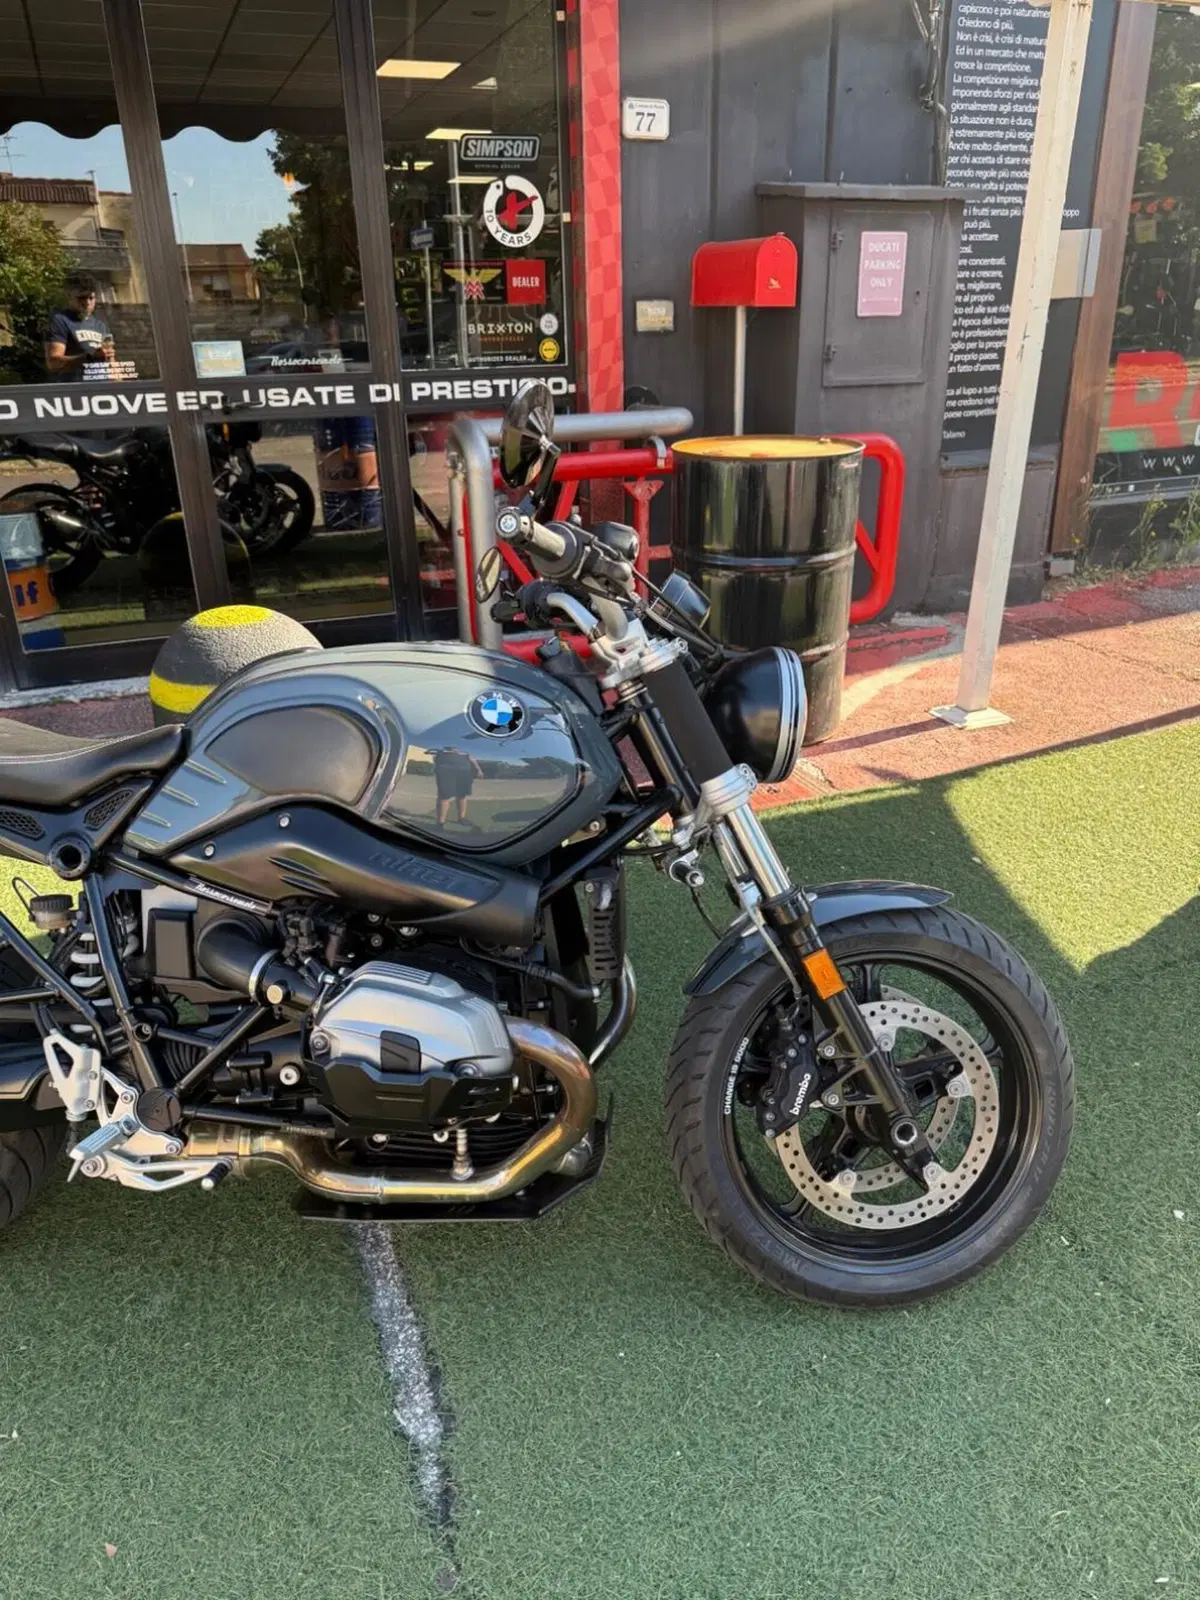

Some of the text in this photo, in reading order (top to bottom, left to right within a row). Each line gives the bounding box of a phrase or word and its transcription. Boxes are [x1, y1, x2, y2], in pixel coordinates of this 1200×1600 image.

[959, 4, 993, 15] capiscono
[1000, 6, 1012, 17] poi
[957, 17, 992, 28] Chiedono
[993, 19, 1000, 29] di
[956, 31, 972, 41] Non
[1001, 34, 1014, 44] crisi
[1015, 35, 1022, 45] di
[955, 45, 965, 55] Ed
[966, 46, 973, 56] in
[974, 48, 984, 56] un
[985, 48, 1014, 58] mercato
[1015, 48, 1027, 58] che
[954, 61, 1031, 73] cresce la competizione.
[953, 73, 1039, 88] La competizione migliora
[952, 86, 993, 98] imponendo
[993, 88, 1012, 99] sforzi
[1013, 91, 1024, 100] per
[951, 100, 998, 113] giornalmente
[998, 102, 1011, 114] agli
[635, 111, 656, 132] 77
[950, 114, 958, 124] La
[959, 114, 994, 125] situazione
[995, 117, 1009, 125] non
[954, 129, 1004, 138] estremamente
[1005, 129, 1016, 140] più
[466, 139, 534, 157] SIMPSON
[949, 140, 970, 151] Anche
[971, 141, 992, 151] molto
[948, 156, 959, 165] per
[960, 154, 970, 164] chi
[971, 155, 995, 164] accetta
[996, 154, 1003, 164] di
[1004, 156, 1021, 165] stare
[975, 168, 997, 180] regole
[998, 168, 1009, 180] più
[982, 180, 998, 191] volta
[999, 180, 1005, 190] si
[972, 206, 989, 216] frutti
[990, 207, 1009, 217] senza
[1010, 207, 1021, 218] più
[964, 219, 978, 230] può
[494, 226, 532, 245] YEARS
[968, 233, 999, 241] accettare
[868, 242, 901, 253] DUCATI
[863, 259, 902, 270] PARKING
[511, 276, 541, 288] DEALER
[870, 277, 894, 288] ONLY
[963, 292, 970, 302] al
[970, 292, 995, 304] proprio
[964, 305, 974, 314] ed
[974, 304, 985, 314] alle
[986, 306, 998, 314] sue
[982, 316, 992, 325] del
[467, 322, 534, 335] BRIXTON
[966, 342, 978, 351] per
[978, 340, 985, 349] la
[954, 351, 978, 363] proprio
[957, 363, 973, 373] fatto
[955, 386, 962, 395] al
[963, 386, 978, 396] lupo
[983, 384, 997, 394] tutti
[34, 392, 168, 418] NUOVE
[242, 385, 356, 409] USATE
[368, 383, 400, 404] DI
[411, 377, 576, 401] PRESTIO.
[957, 397, 983, 407] credono
[984, 395, 995, 405] nel
[943, 410, 962, 420] paese
[476, 691, 520, 708] BMW
[789, 1072, 812, 1116] brembo
